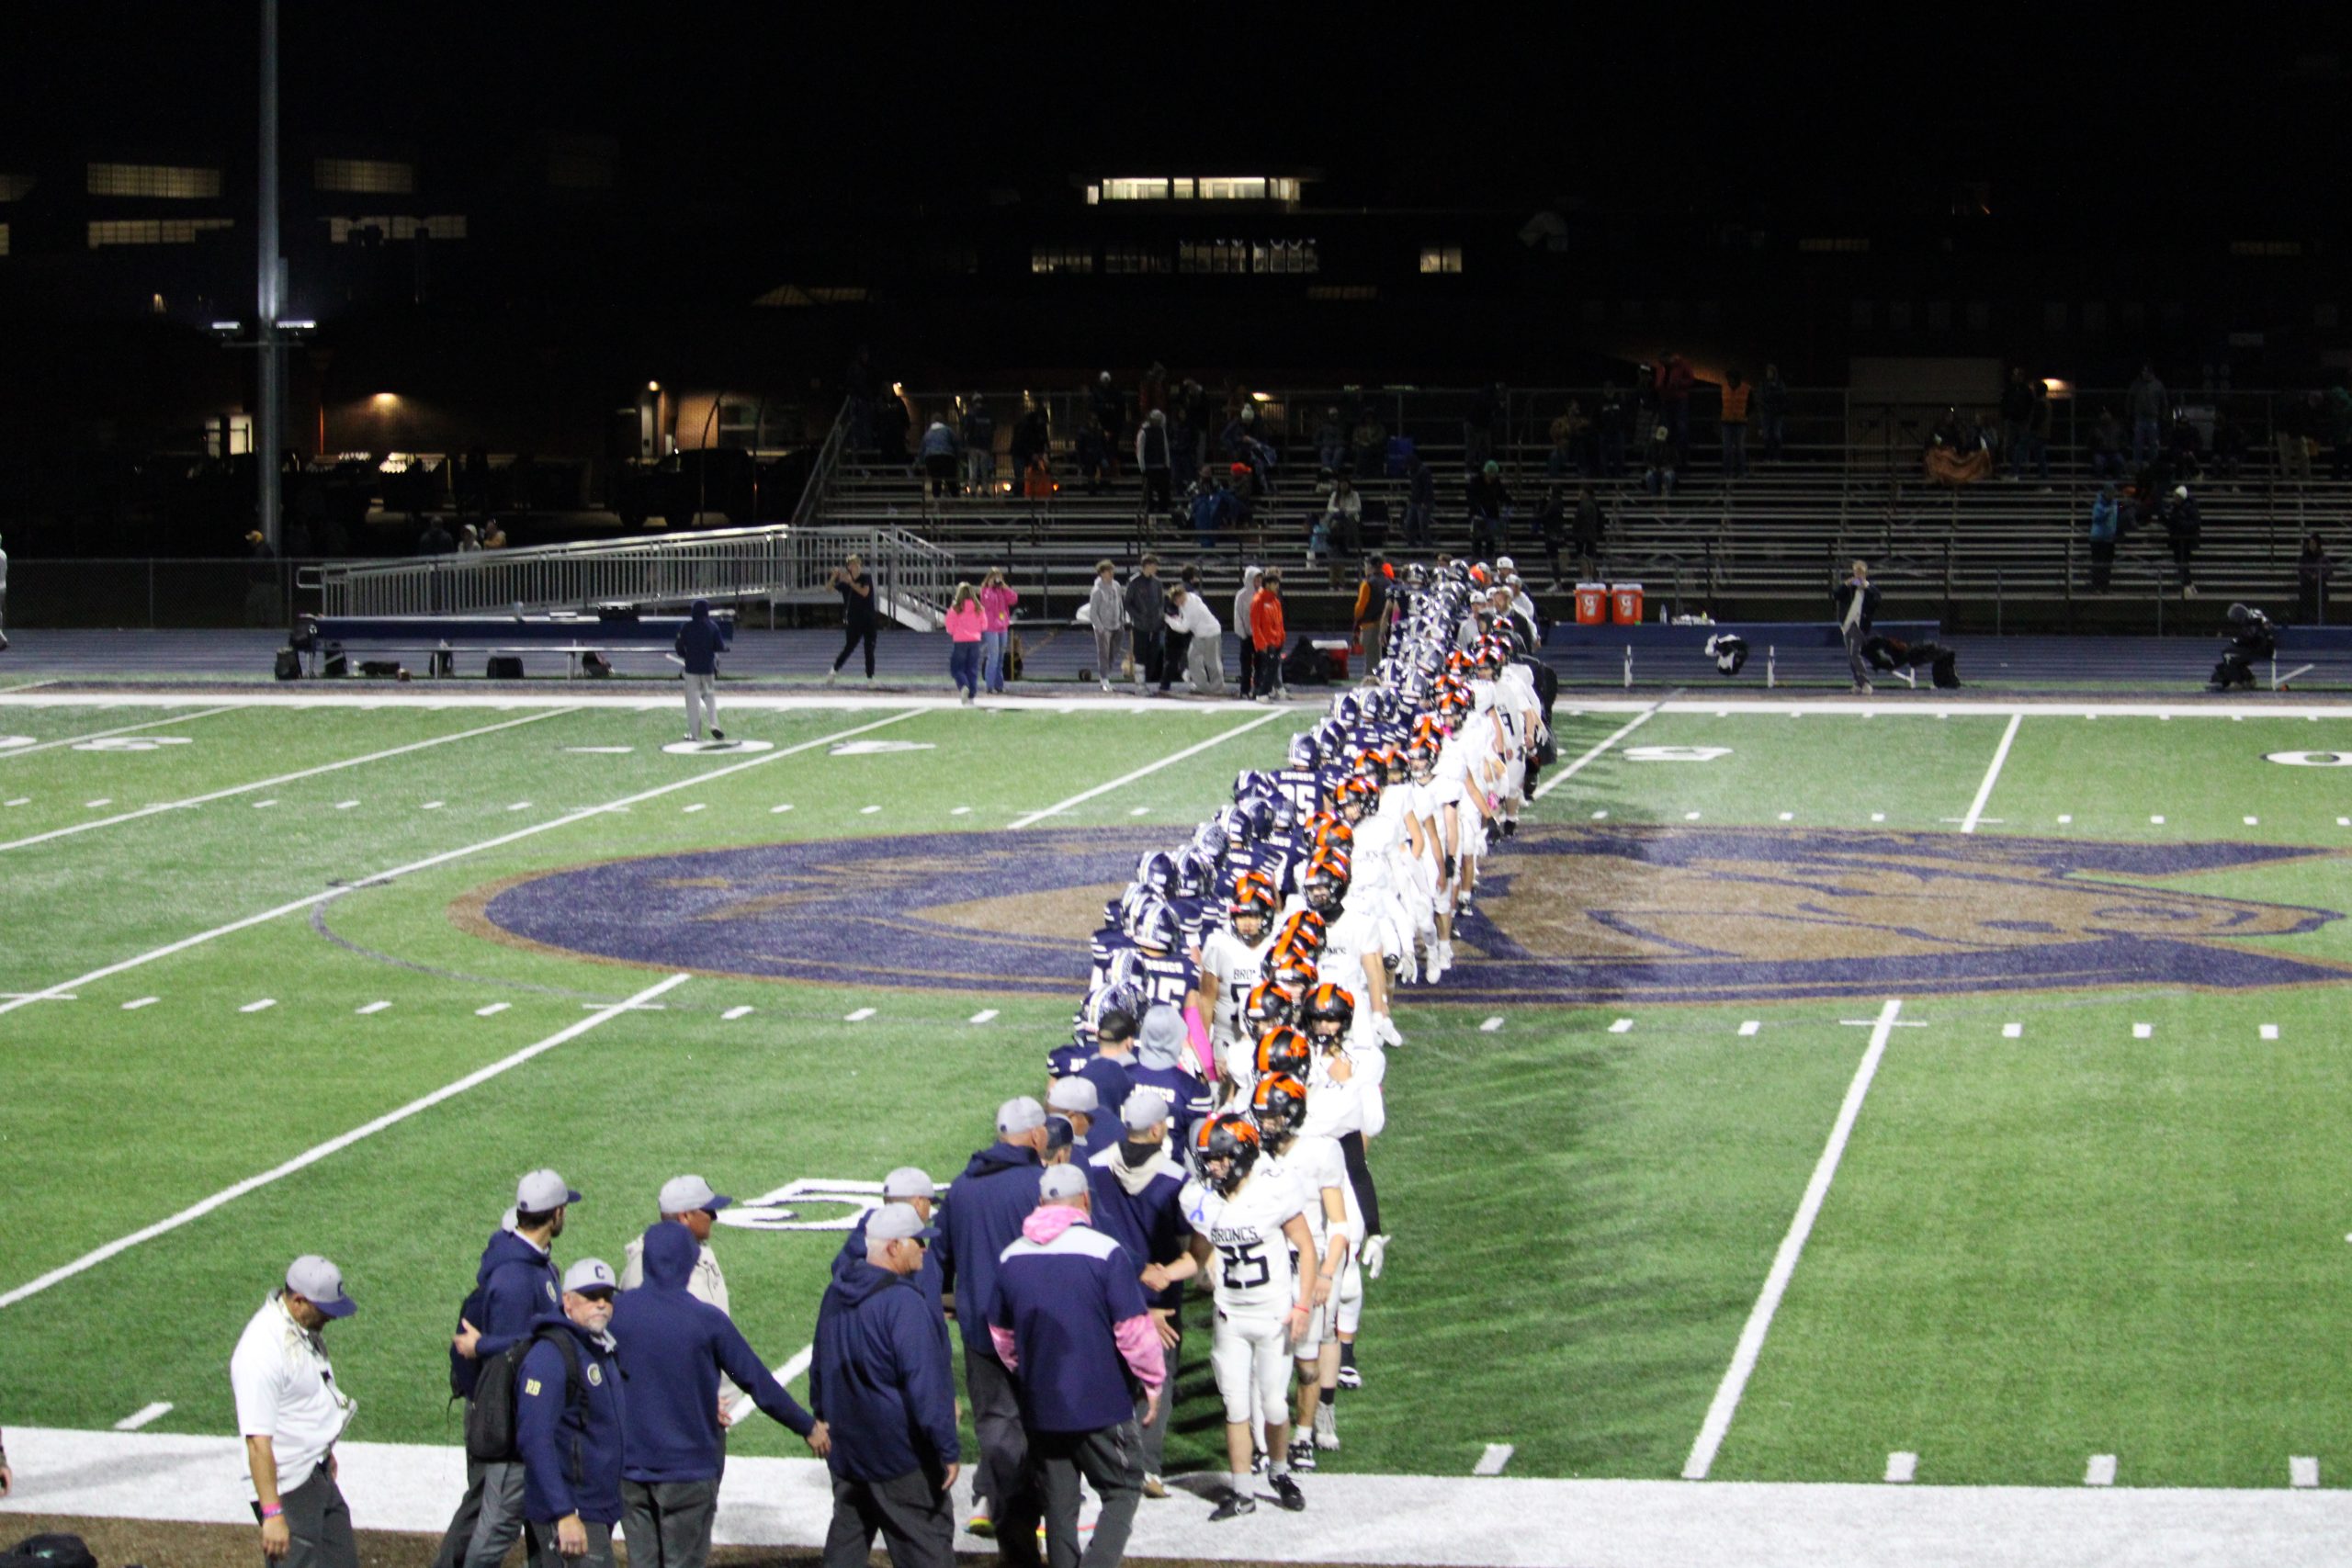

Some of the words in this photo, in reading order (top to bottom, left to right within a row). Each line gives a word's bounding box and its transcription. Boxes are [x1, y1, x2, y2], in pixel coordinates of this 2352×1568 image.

[1211, 1226, 1260, 1244] BRONCS
[594, 1265, 605, 1280] C
[1216, 1240, 1271, 1290] 25
[525, 1378, 542, 1396] RB
